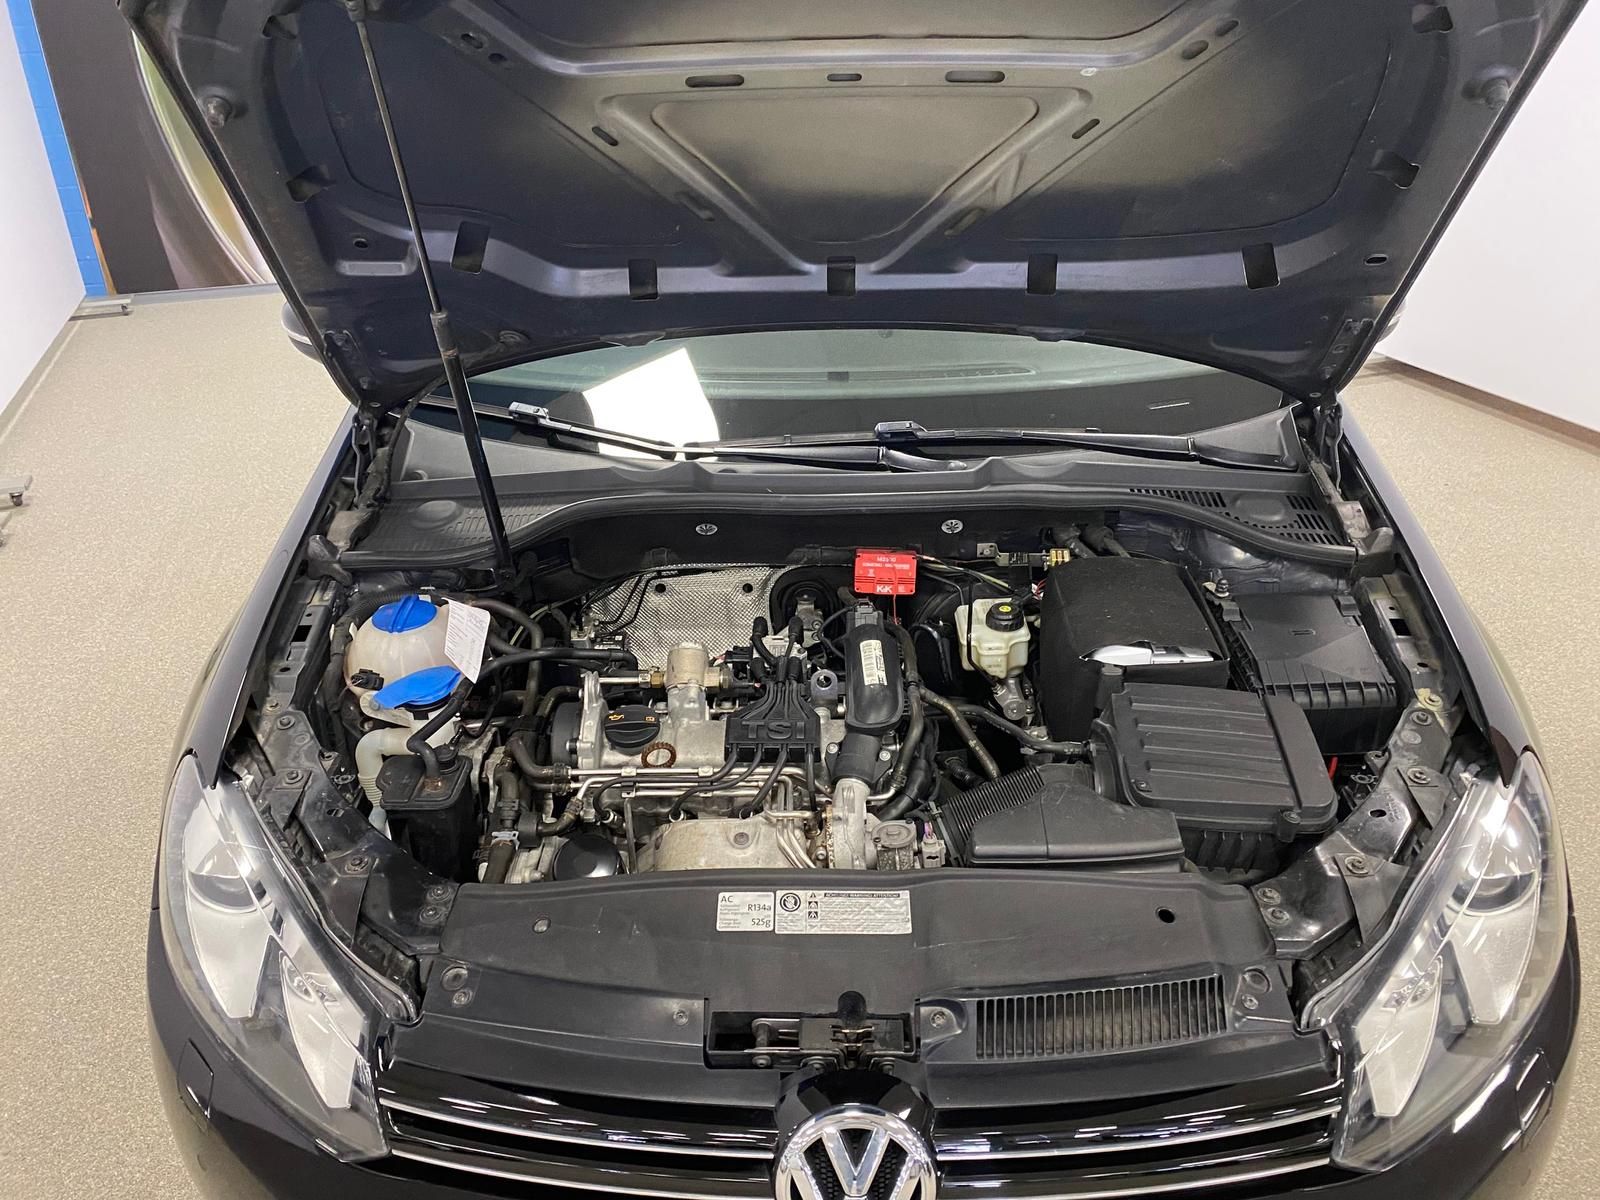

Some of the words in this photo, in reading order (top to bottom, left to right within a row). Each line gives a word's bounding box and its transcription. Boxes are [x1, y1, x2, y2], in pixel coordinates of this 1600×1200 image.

[741, 721, 805, 740] TSI
[720, 895, 734, 903] AC
[747, 903, 772, 912] R134a
[751, 918, 772, 928] 525g
